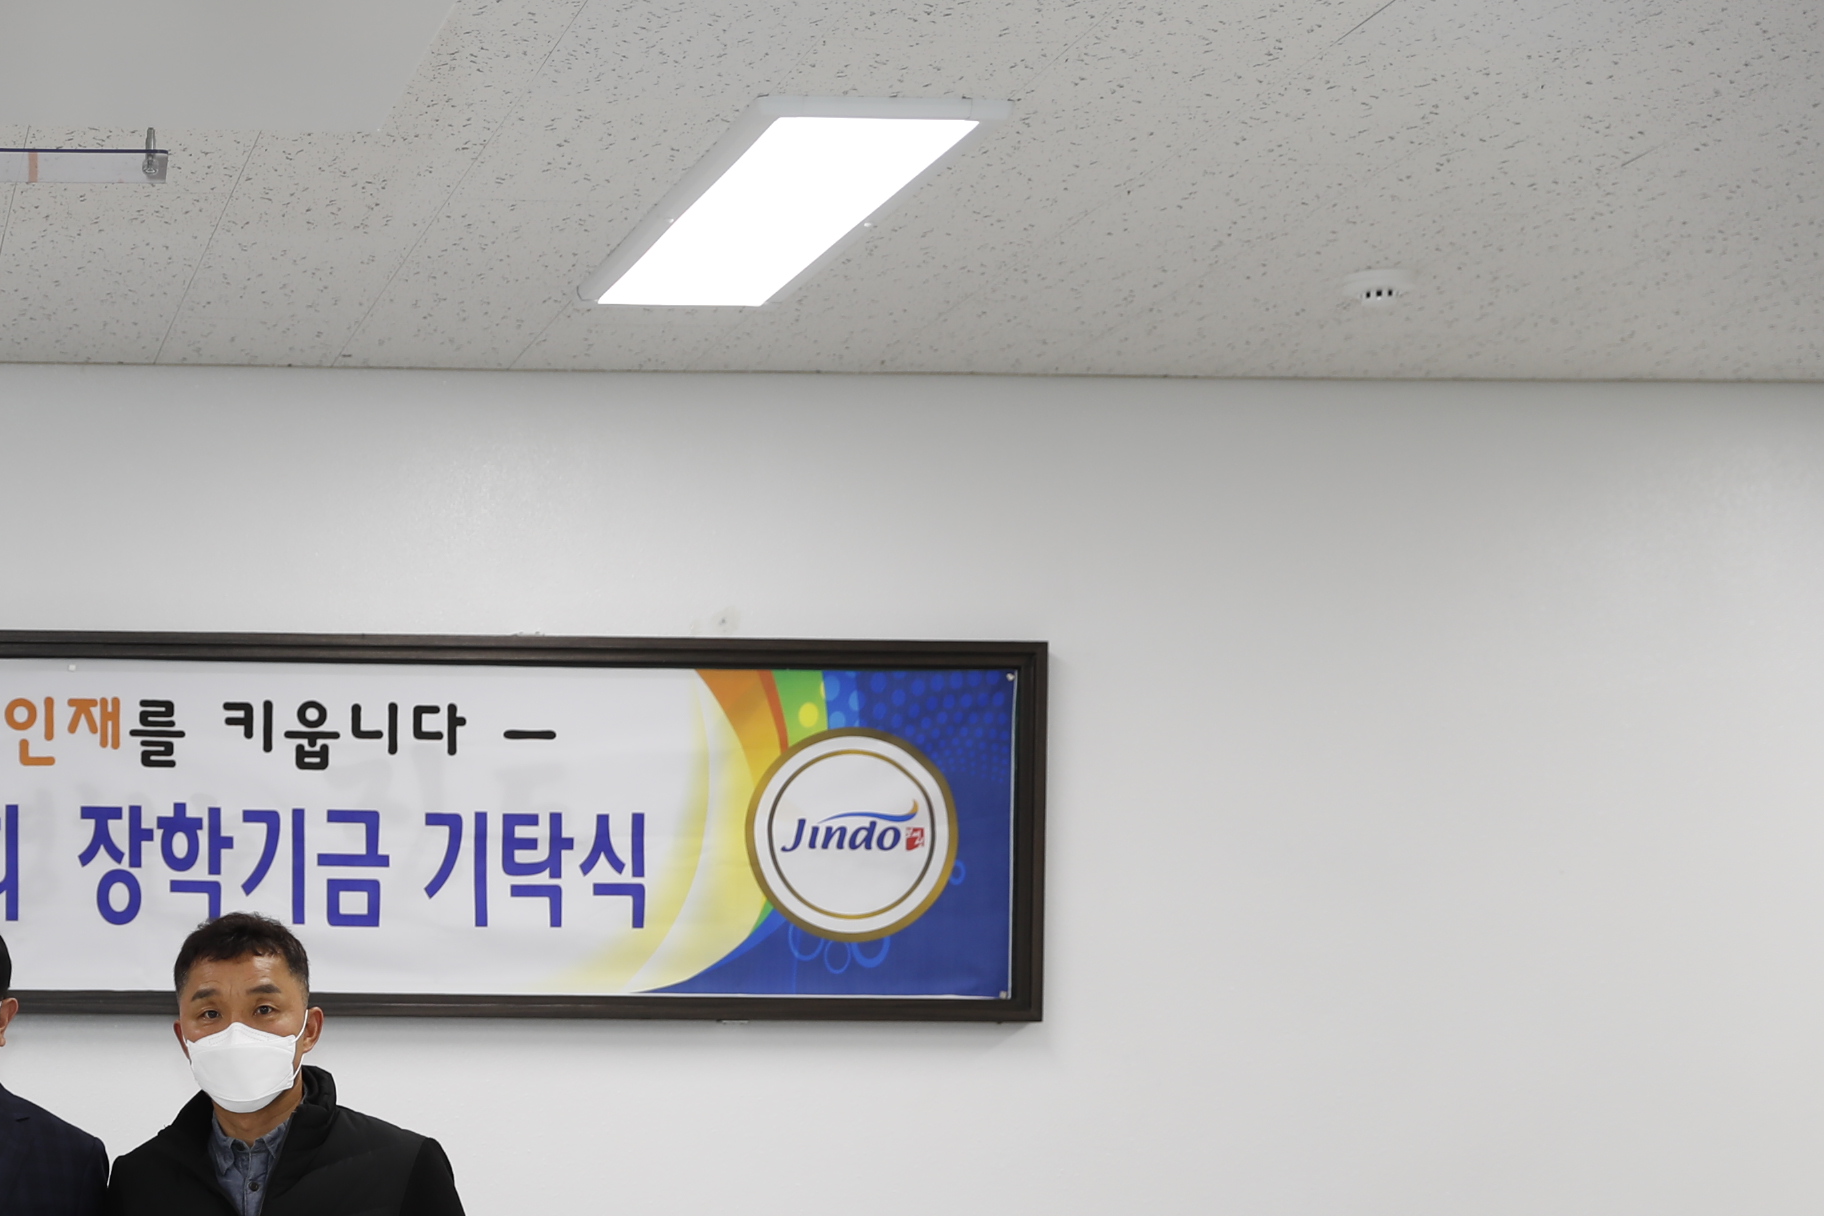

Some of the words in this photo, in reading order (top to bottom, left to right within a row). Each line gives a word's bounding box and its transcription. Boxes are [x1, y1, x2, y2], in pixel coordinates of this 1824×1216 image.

[5, 697, 187, 770] 인재를
[223, 700, 468, 772] 키웁니다
[78, 802, 391, 927] 장학기금
[424, 812, 647, 930] 기탁식
[781, 818, 901, 852] Jindo
